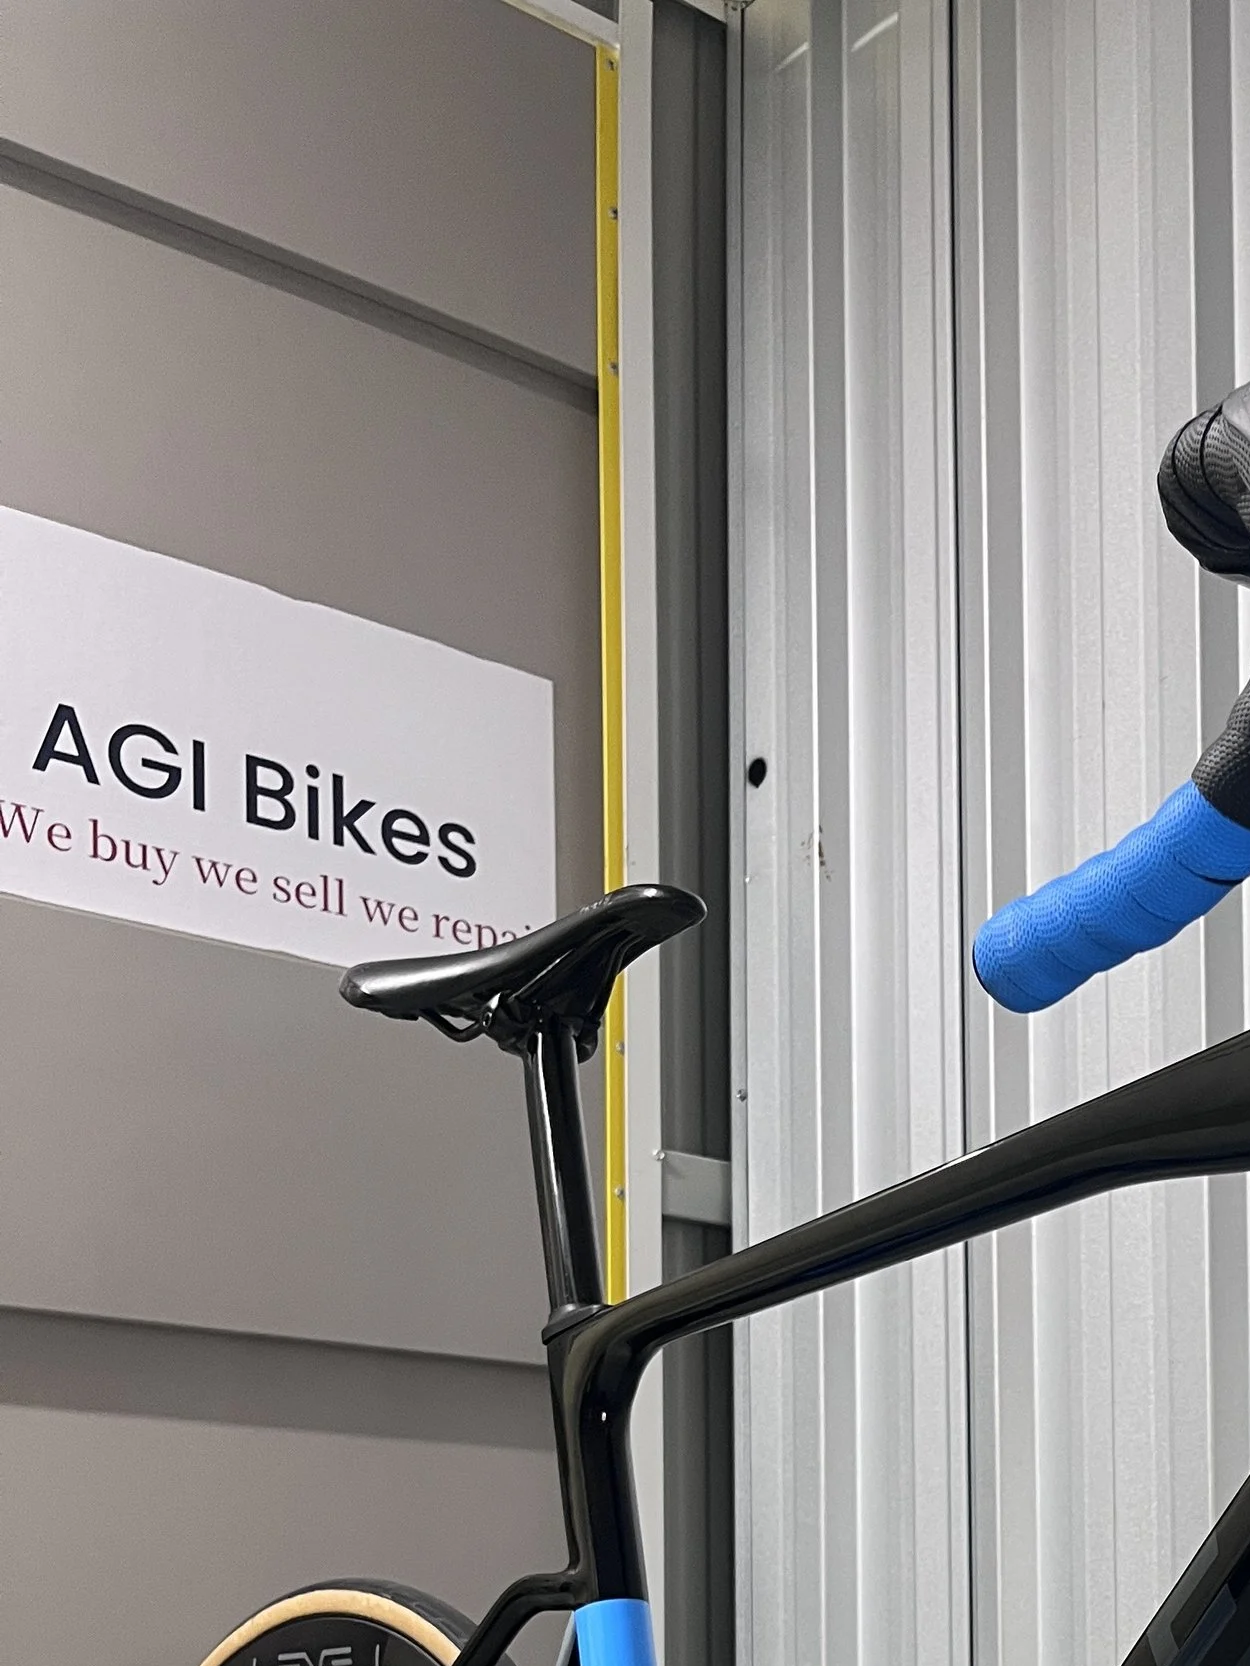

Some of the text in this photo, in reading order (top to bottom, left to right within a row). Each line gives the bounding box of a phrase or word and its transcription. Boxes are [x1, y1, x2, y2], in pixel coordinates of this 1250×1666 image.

[31, 703, 477, 878] AGI Bikes
[0, 801, 532, 950] We buy we sell we repa
